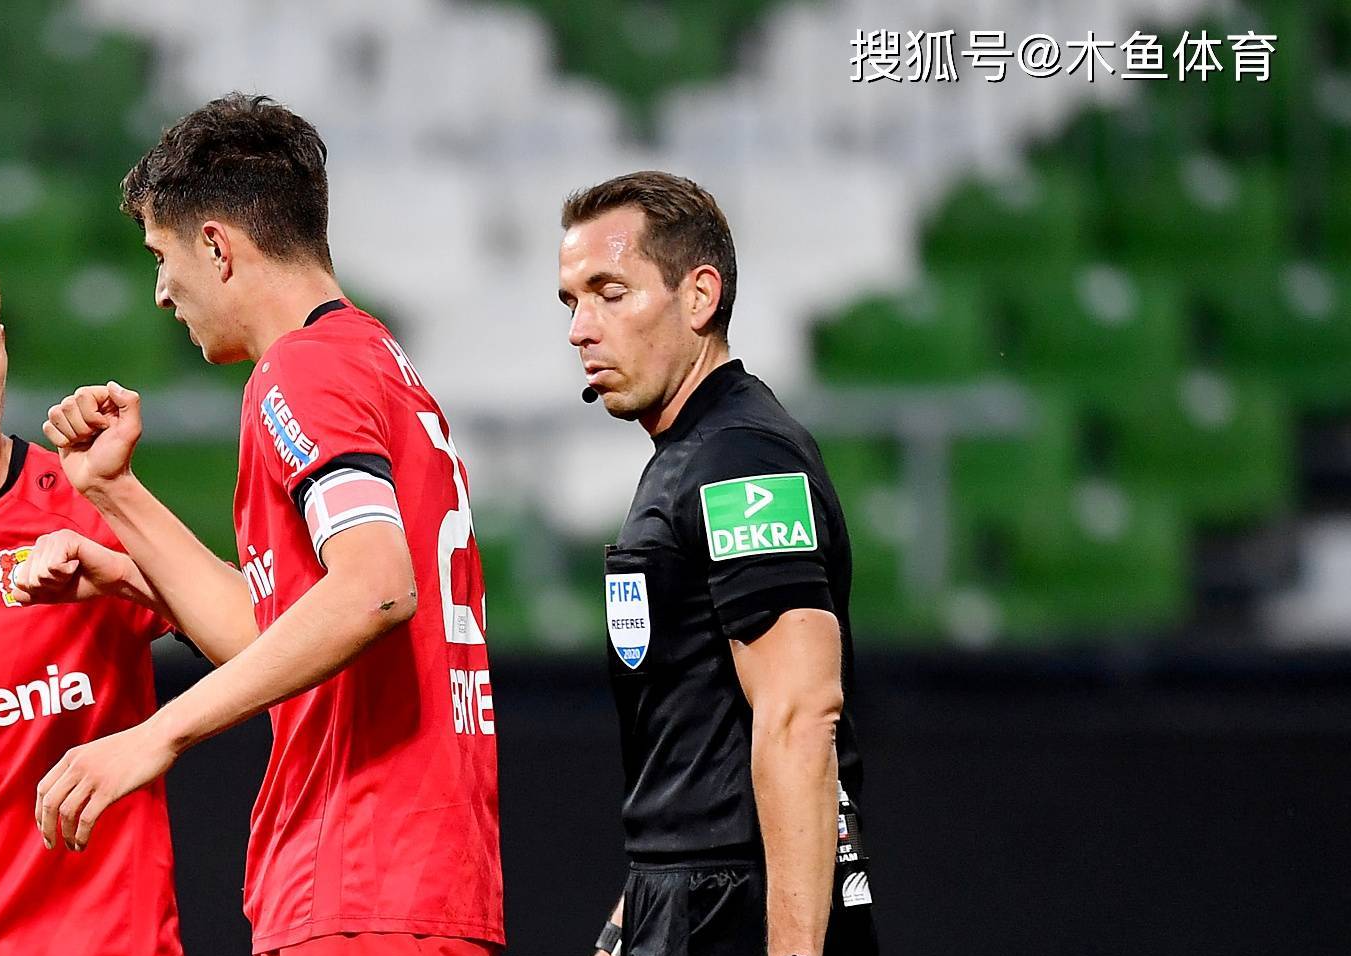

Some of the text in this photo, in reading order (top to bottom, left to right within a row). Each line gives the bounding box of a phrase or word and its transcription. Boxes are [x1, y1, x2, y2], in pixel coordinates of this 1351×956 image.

[712, 521, 812, 556] DEKRA
[609, 581, 642, 603] FIFA
[611, 617, 646, 630] REFEREE
[622, 646, 641, 660] 2020
